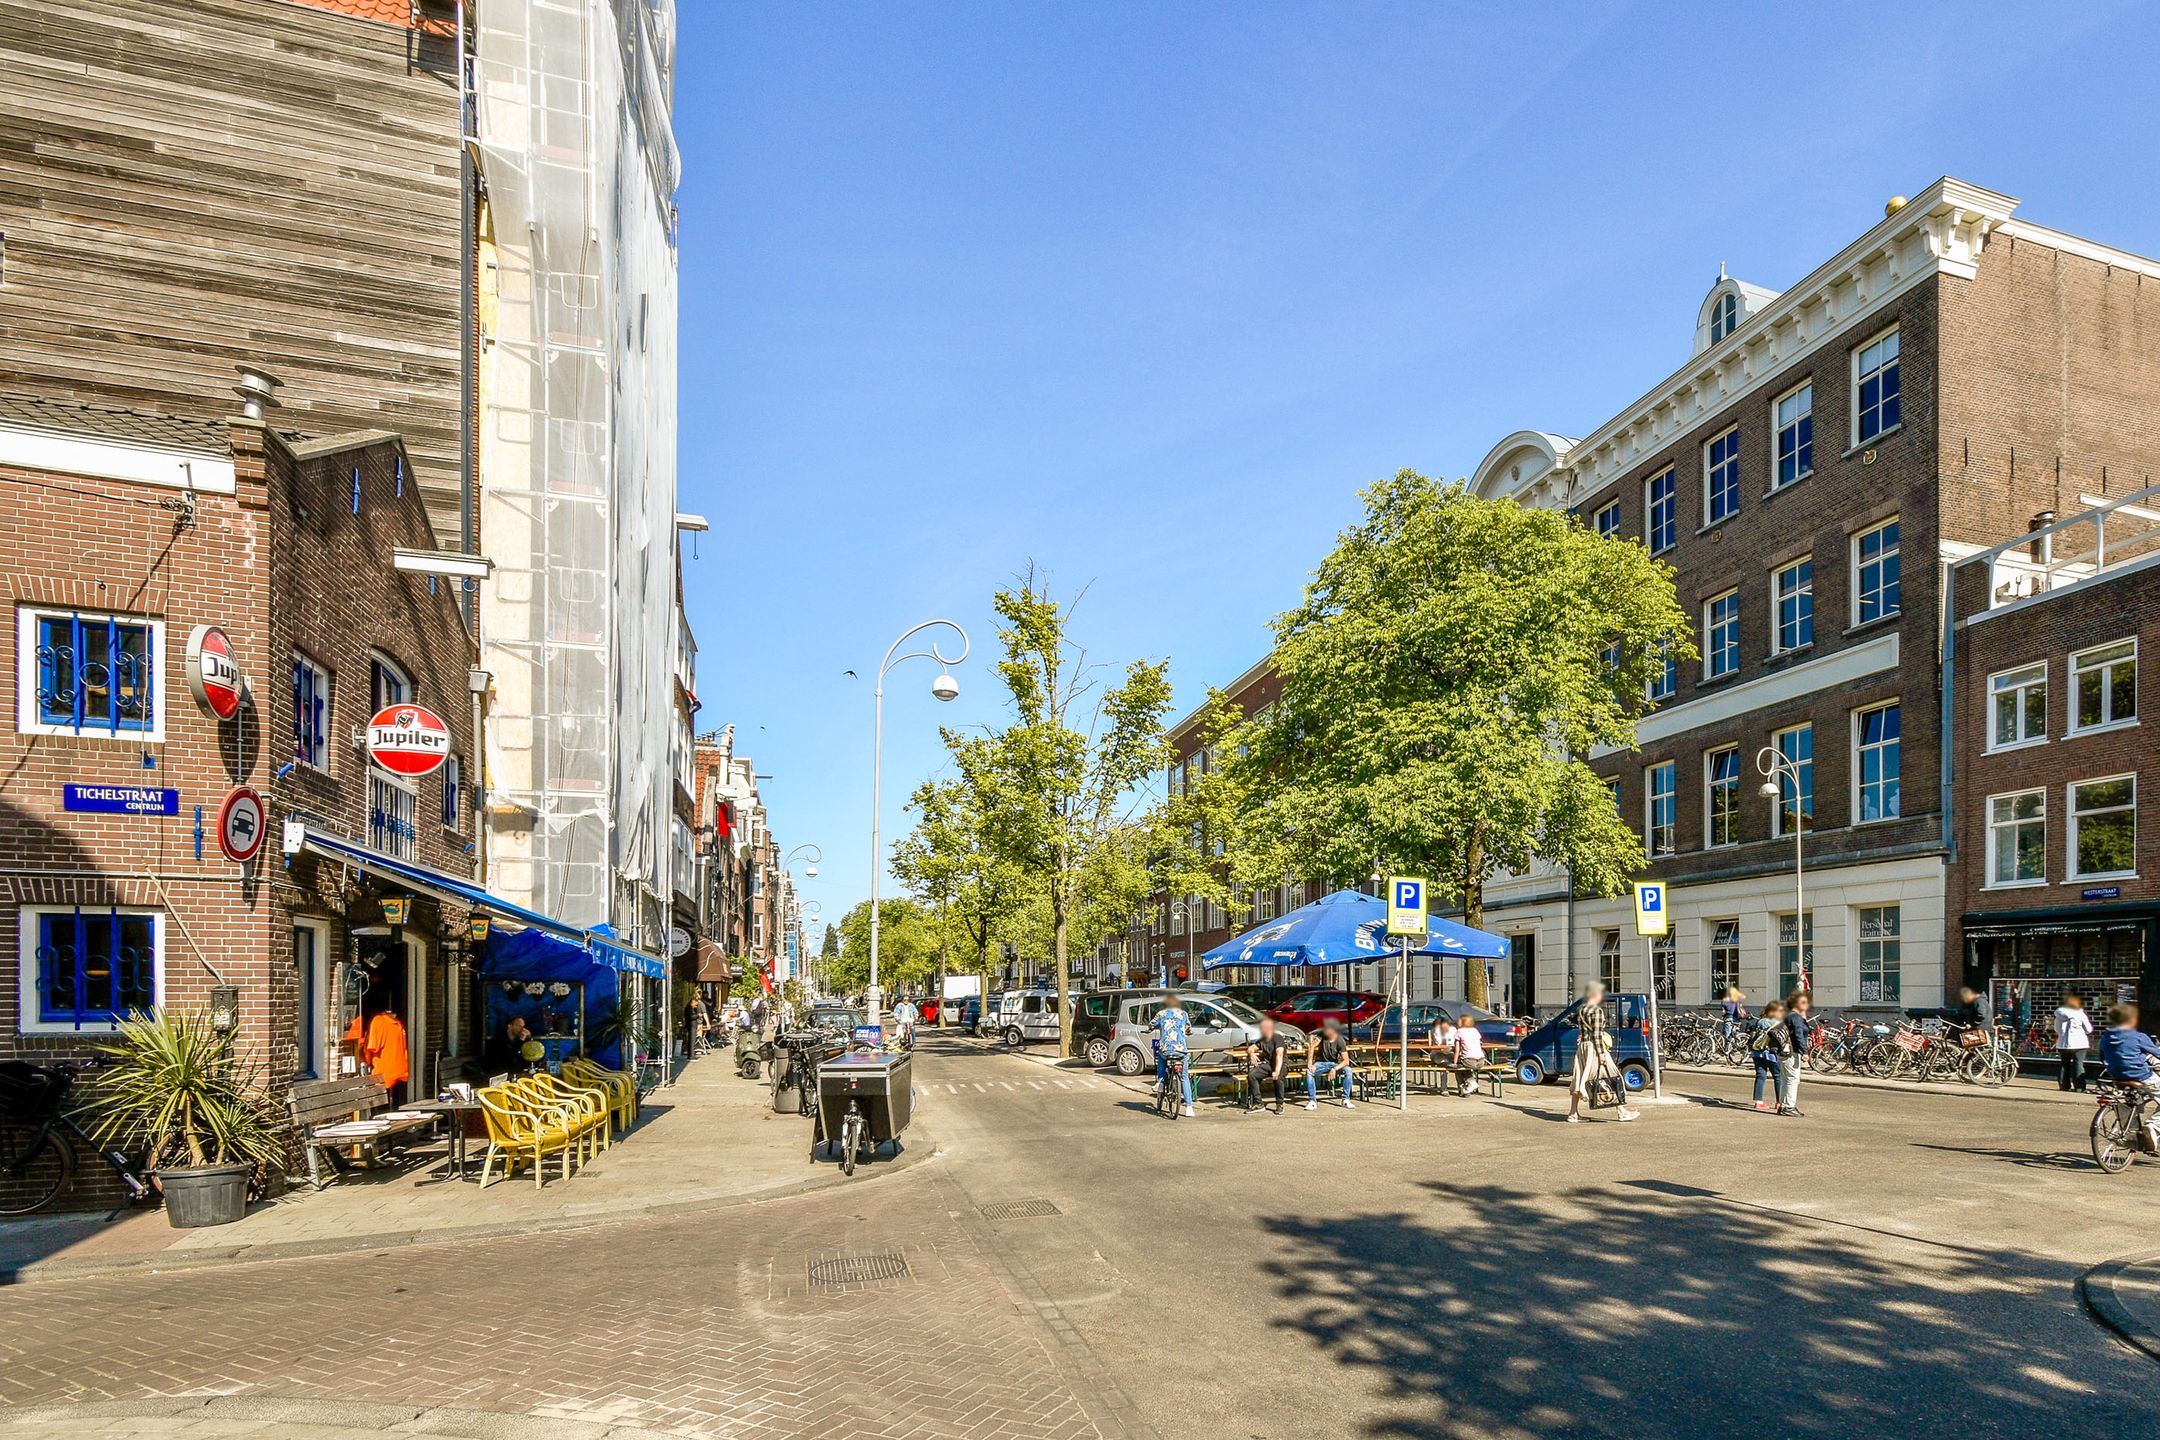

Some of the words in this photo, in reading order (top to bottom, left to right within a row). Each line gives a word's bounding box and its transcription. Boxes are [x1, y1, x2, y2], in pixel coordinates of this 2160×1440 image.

[373, 729, 446, 747] Jupiler
[75, 787, 163, 802] TICHELSTRAAT
[125, 802, 164, 811] CENTRUM
[1401, 884, 1415, 906] P
[1644, 889, 1657, 910] P
[1780, 931, 1797, 942] and
[1861, 962, 1880, 971] Scan
